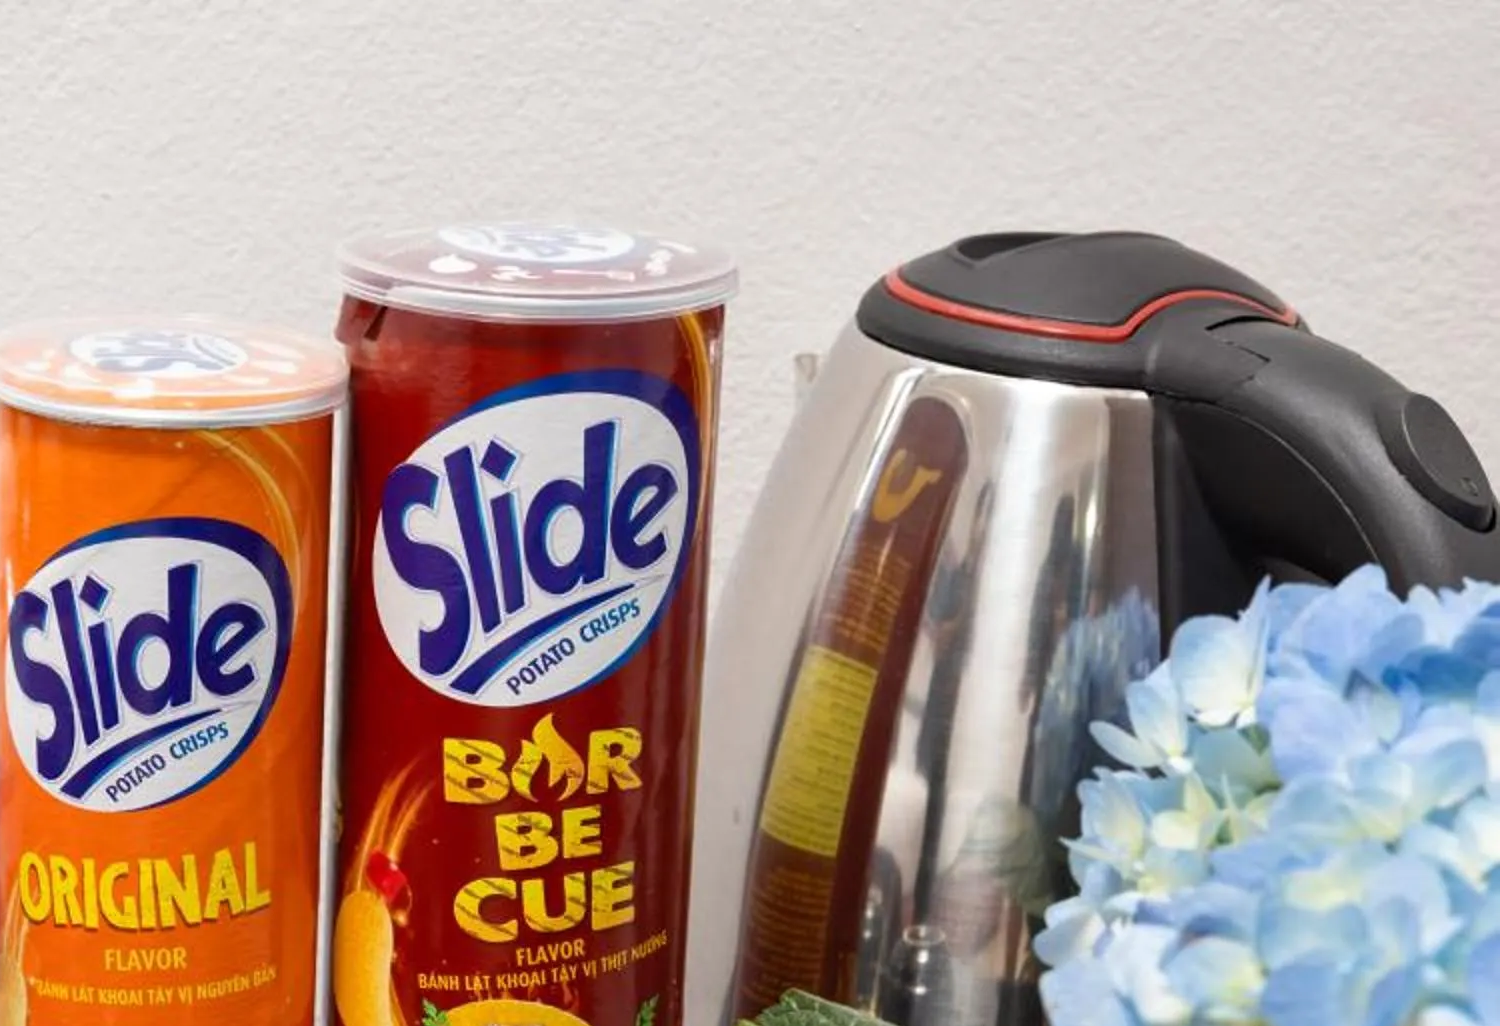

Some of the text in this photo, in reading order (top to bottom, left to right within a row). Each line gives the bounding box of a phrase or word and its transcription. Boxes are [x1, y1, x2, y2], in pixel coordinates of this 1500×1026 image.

[381, 420, 679, 677] Slide
[9, 563, 267, 780] Slide
[506, 599, 642, 695] POTATO CRISPS
[105, 721, 230, 802] POTATO CRISPS
[494, 805, 602, 871] BE
[19, 841, 271, 931] ORIGINAL
[453, 861, 635, 943] CUE
[104, 947, 188, 971] FLAVOR
[497, 969, 546, 989] KHOAI
[515, 938, 585, 967] FLAVOR
